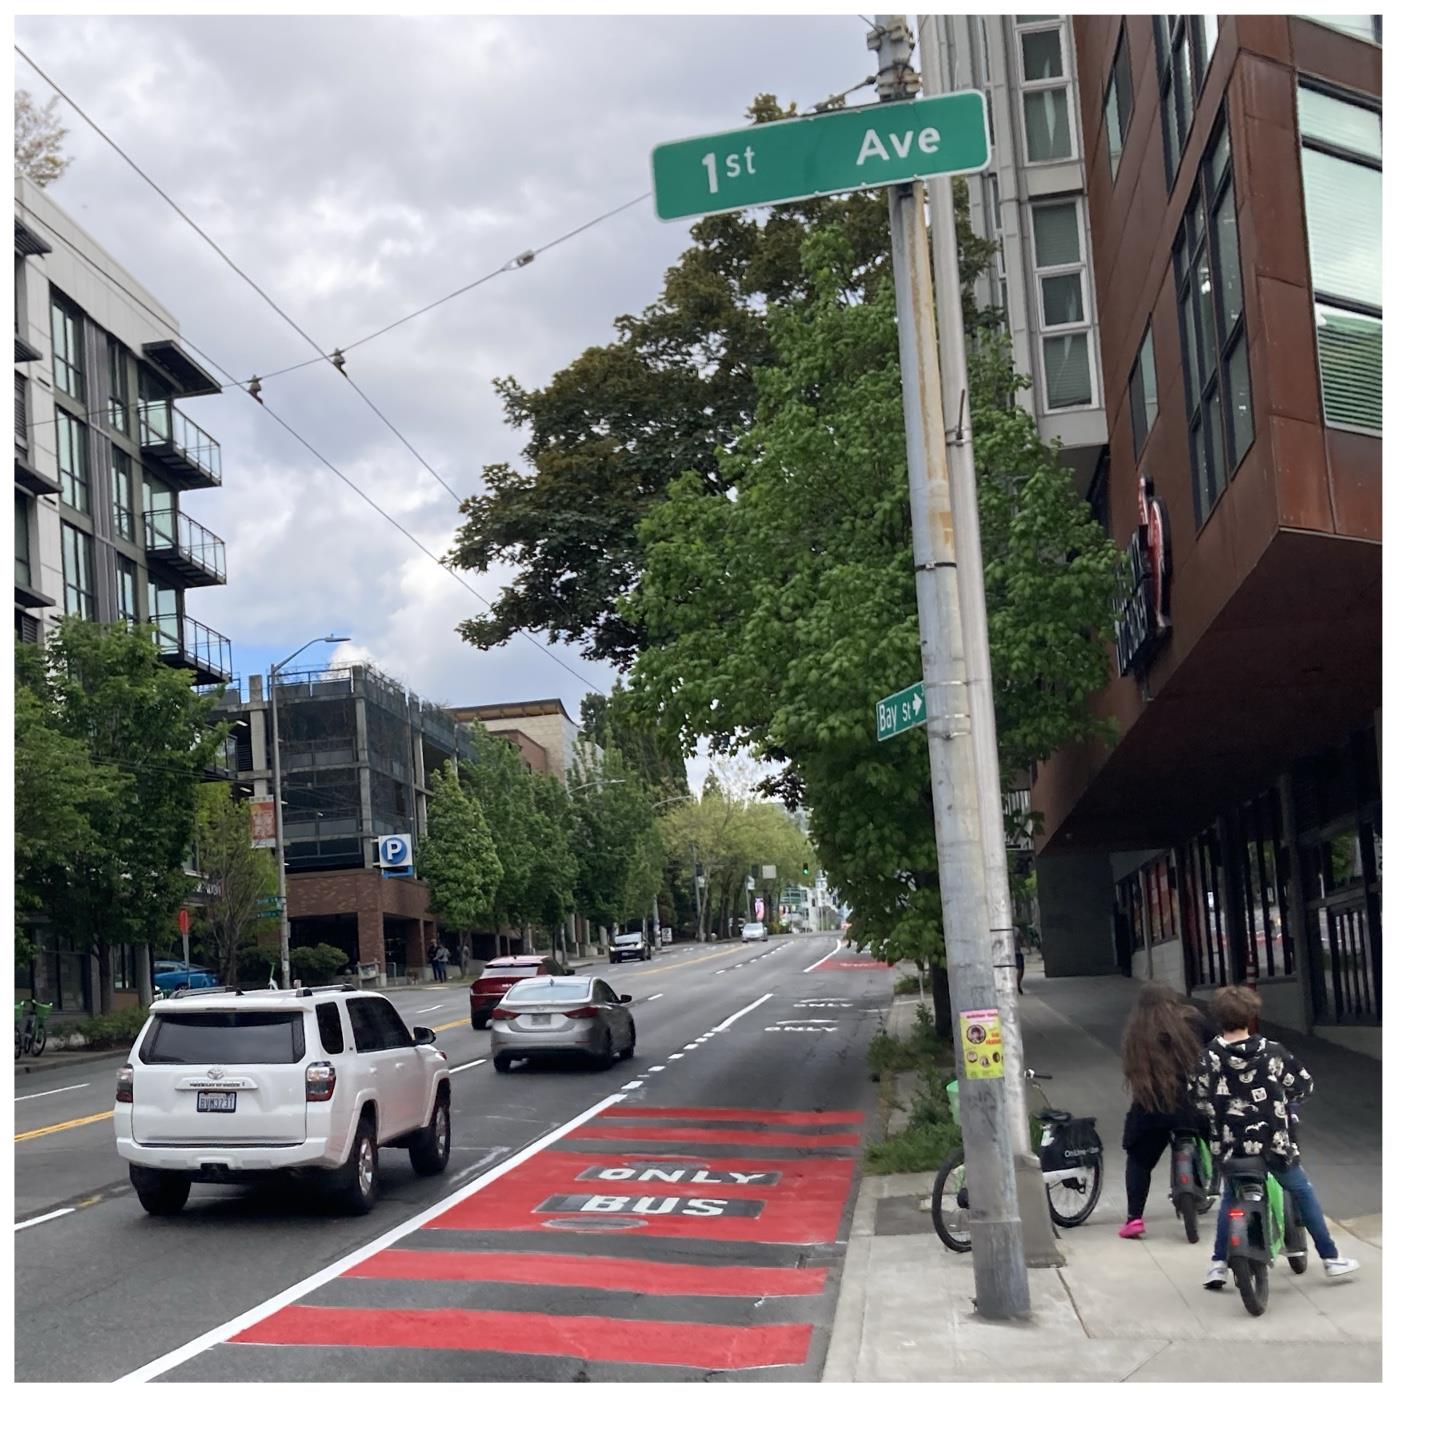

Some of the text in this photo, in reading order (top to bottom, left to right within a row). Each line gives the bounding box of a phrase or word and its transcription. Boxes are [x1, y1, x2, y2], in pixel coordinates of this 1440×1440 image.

[702, 126, 941, 194] 1st Ave
[880, 703, 897, 732] Bay
[387, 841, 401, 860] P
[598, 1168, 767, 1184] ONLY
[580, 1195, 728, 1217] BUS
